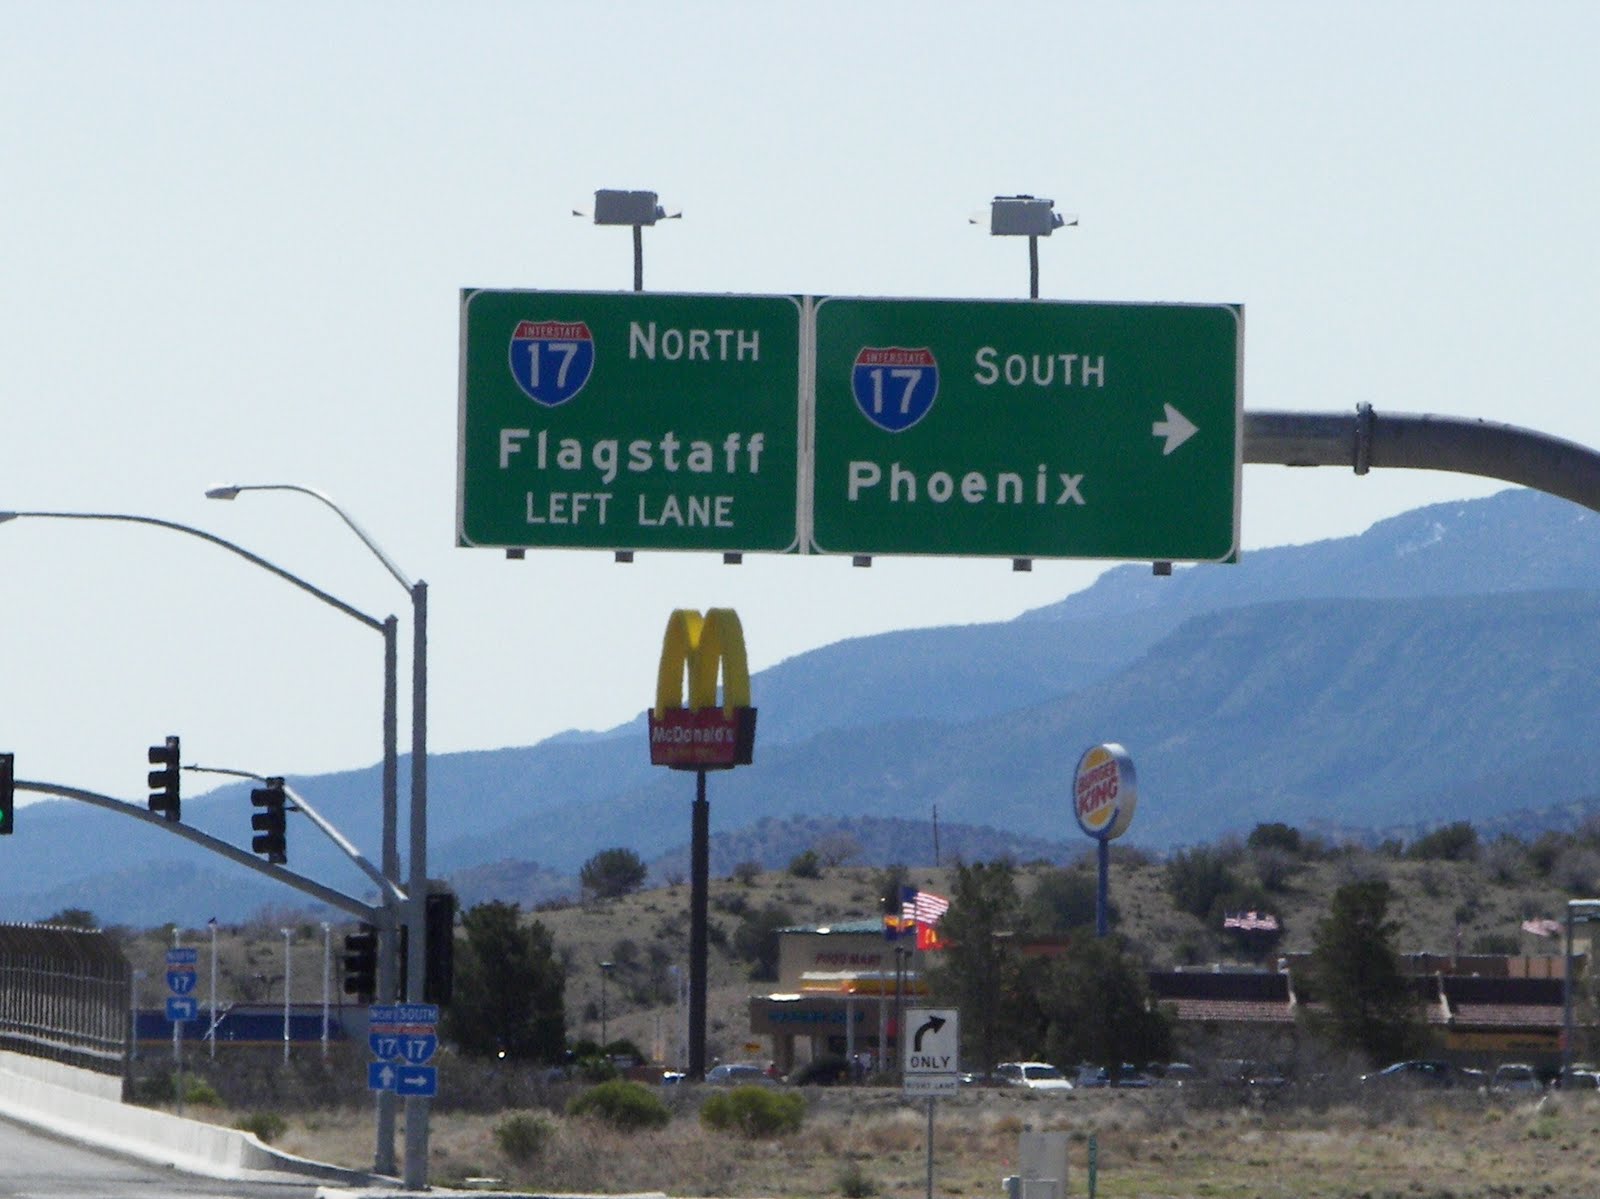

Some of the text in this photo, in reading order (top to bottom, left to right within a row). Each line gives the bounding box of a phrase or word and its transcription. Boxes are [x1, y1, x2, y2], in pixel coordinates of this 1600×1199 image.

[523, 325, 582, 338] INTERSTATE
[628, 321, 760, 361] NORTH
[527, 342, 578, 388] 17
[866, 352, 926, 364] INTERSTATE
[973, 346, 1105, 388] SOUTH
[869, 368, 922, 414] 17
[499, 428, 765, 485] Flagstaff
[847, 460, 1086, 505] Phoenix
[526, 491, 735, 527] LEFT LANE
[653, 726, 735, 743] McDonald's
[1079, 776, 1118, 816] KING
[174, 976, 189, 992] 17
[400, 1007, 436, 1020] SOUTH
[378, 1038, 398, 1055] 17
[406, 1039, 427, 1059] 17
[910, 1056, 951, 1069] ONLY
